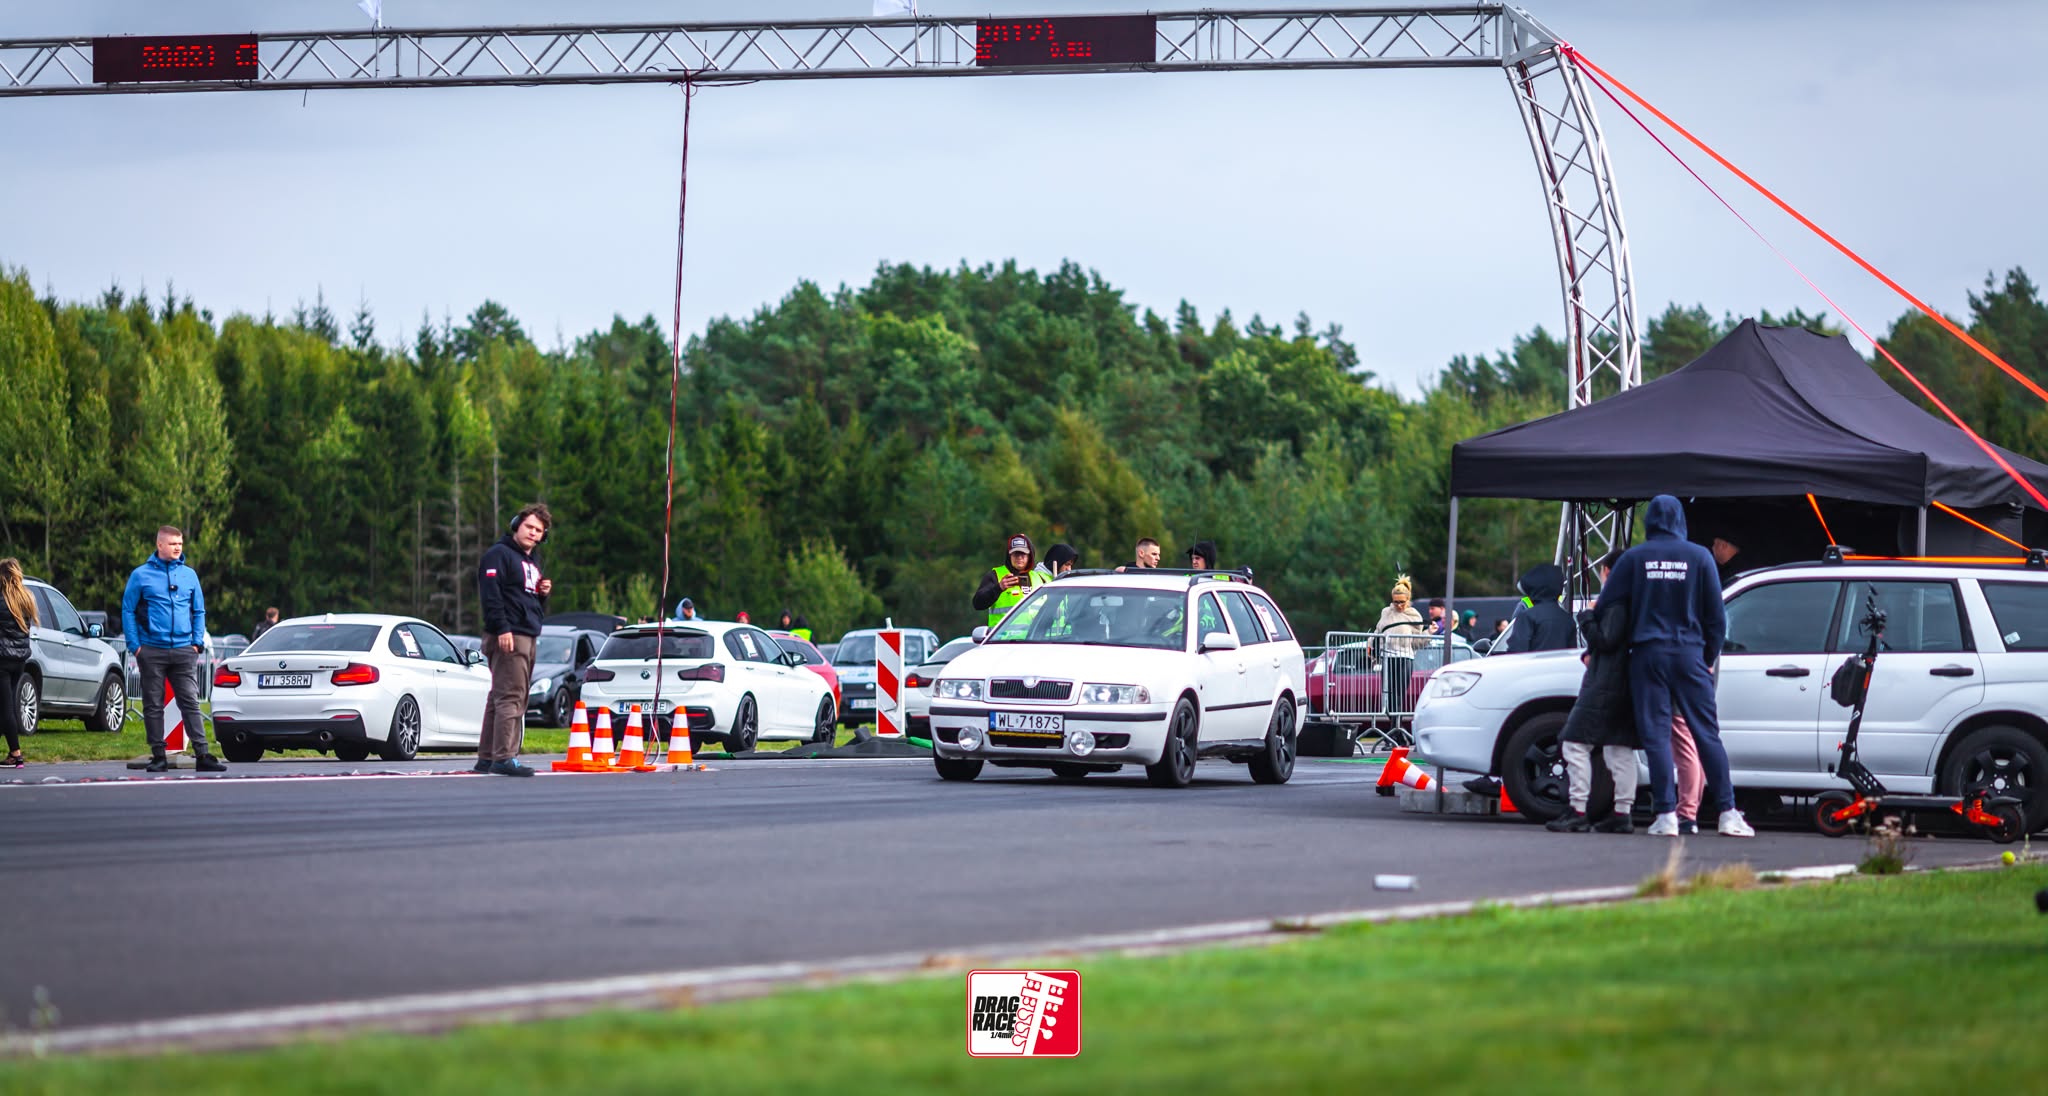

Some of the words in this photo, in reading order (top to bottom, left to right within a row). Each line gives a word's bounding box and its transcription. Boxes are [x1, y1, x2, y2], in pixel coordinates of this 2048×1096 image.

[265, 675, 275, 686] WI
[280, 674, 309, 686] 358RW
[999, 714, 1014, 728] WL
[1019, 715, 1060, 730] 7187S
